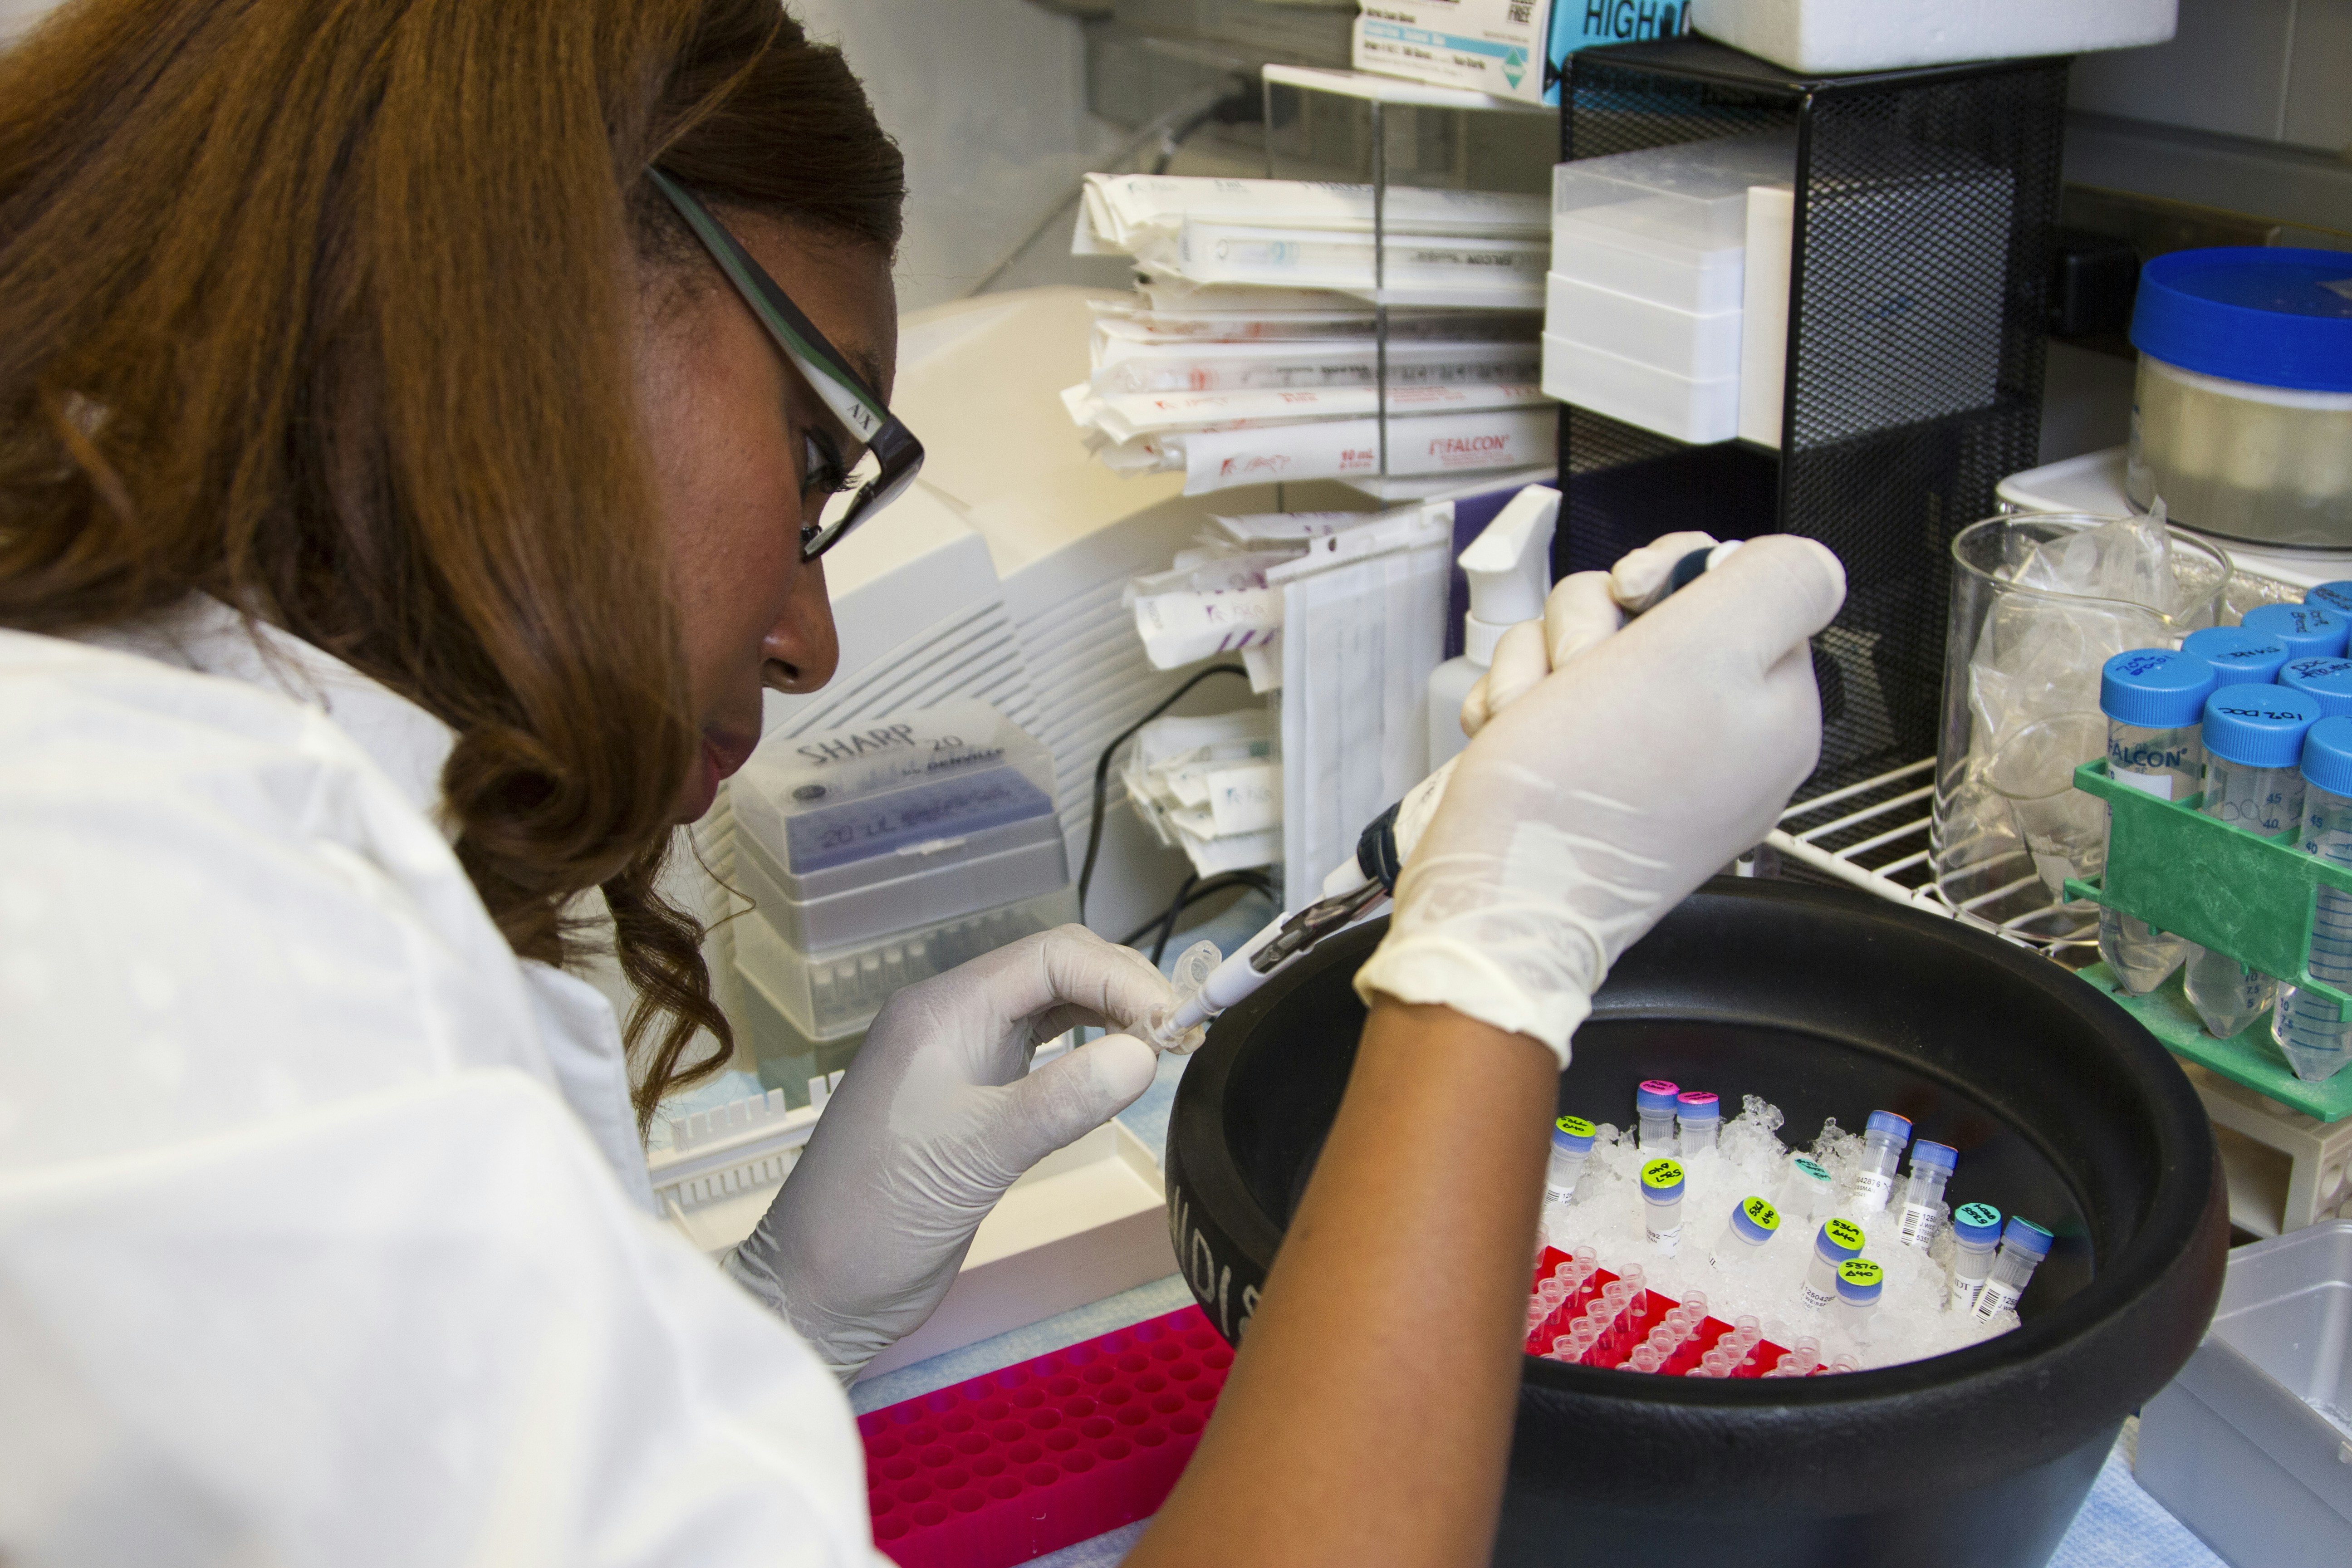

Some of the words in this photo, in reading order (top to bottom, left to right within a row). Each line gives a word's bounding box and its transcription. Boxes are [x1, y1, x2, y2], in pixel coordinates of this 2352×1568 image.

[796, 723, 916, 767] SHARP
[2266, 793, 2282, 804] 45
[2263, 819, 2279, 829] 40
[2306, 841, 2318, 855] 40
[2281, 998, 2289, 1011] 10
